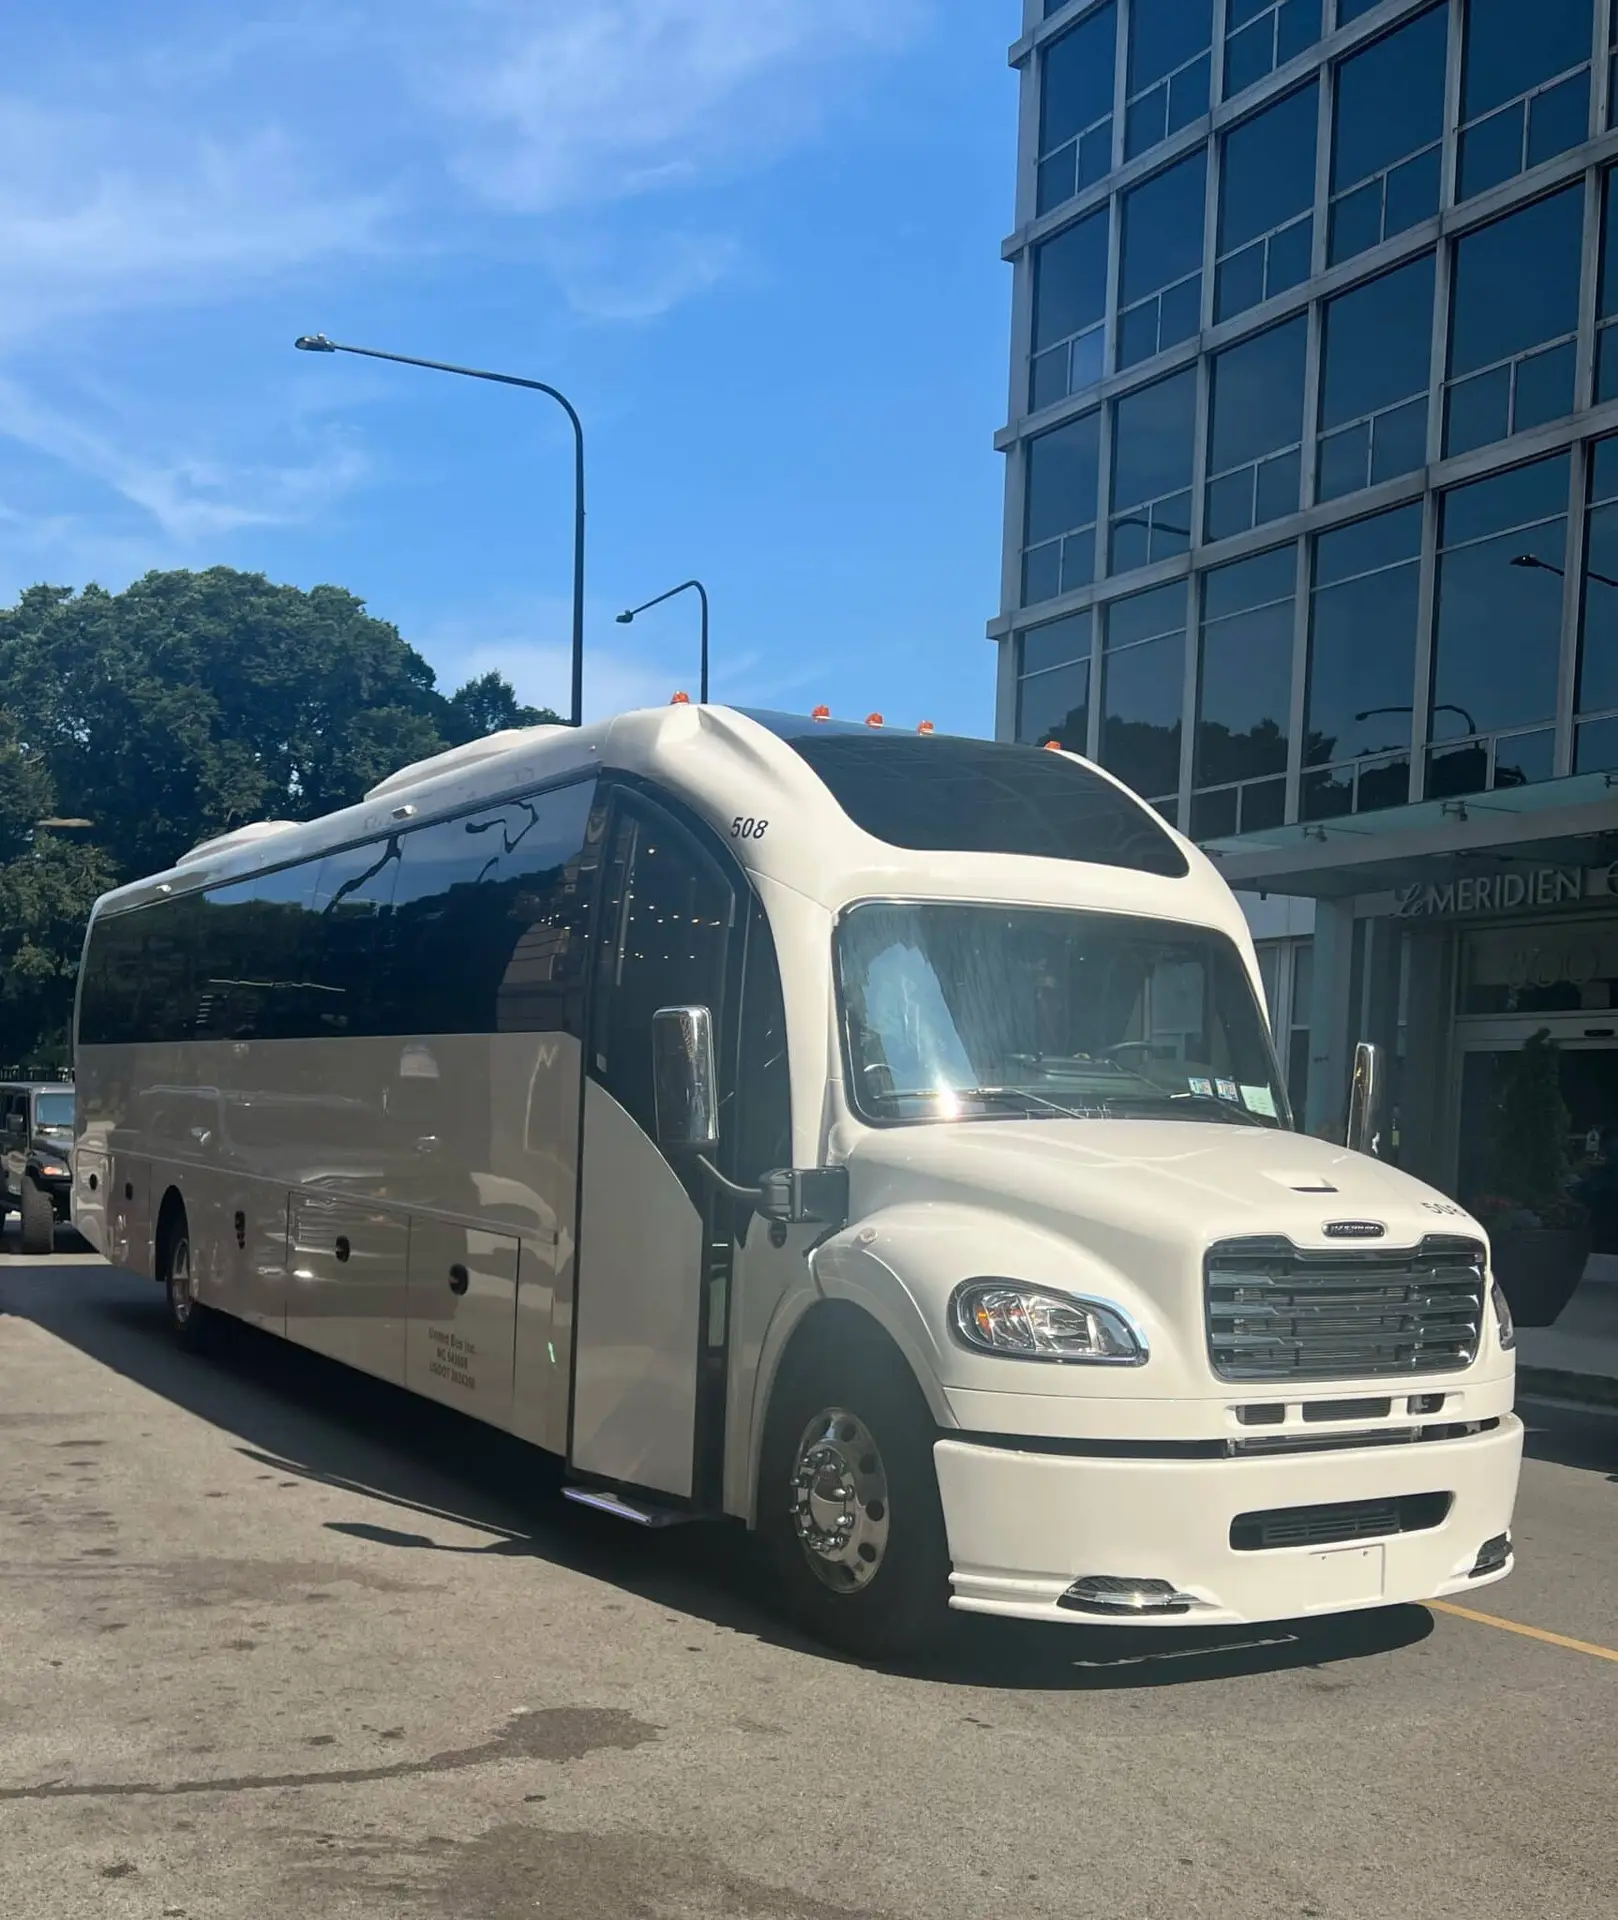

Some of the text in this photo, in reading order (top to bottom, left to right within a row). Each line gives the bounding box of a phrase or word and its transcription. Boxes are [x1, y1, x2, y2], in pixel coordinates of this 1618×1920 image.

[731, 817, 769, 839] 508
[1389, 883, 1424, 918] Le
[1427, 867, 1582, 915] MERIDIEN
